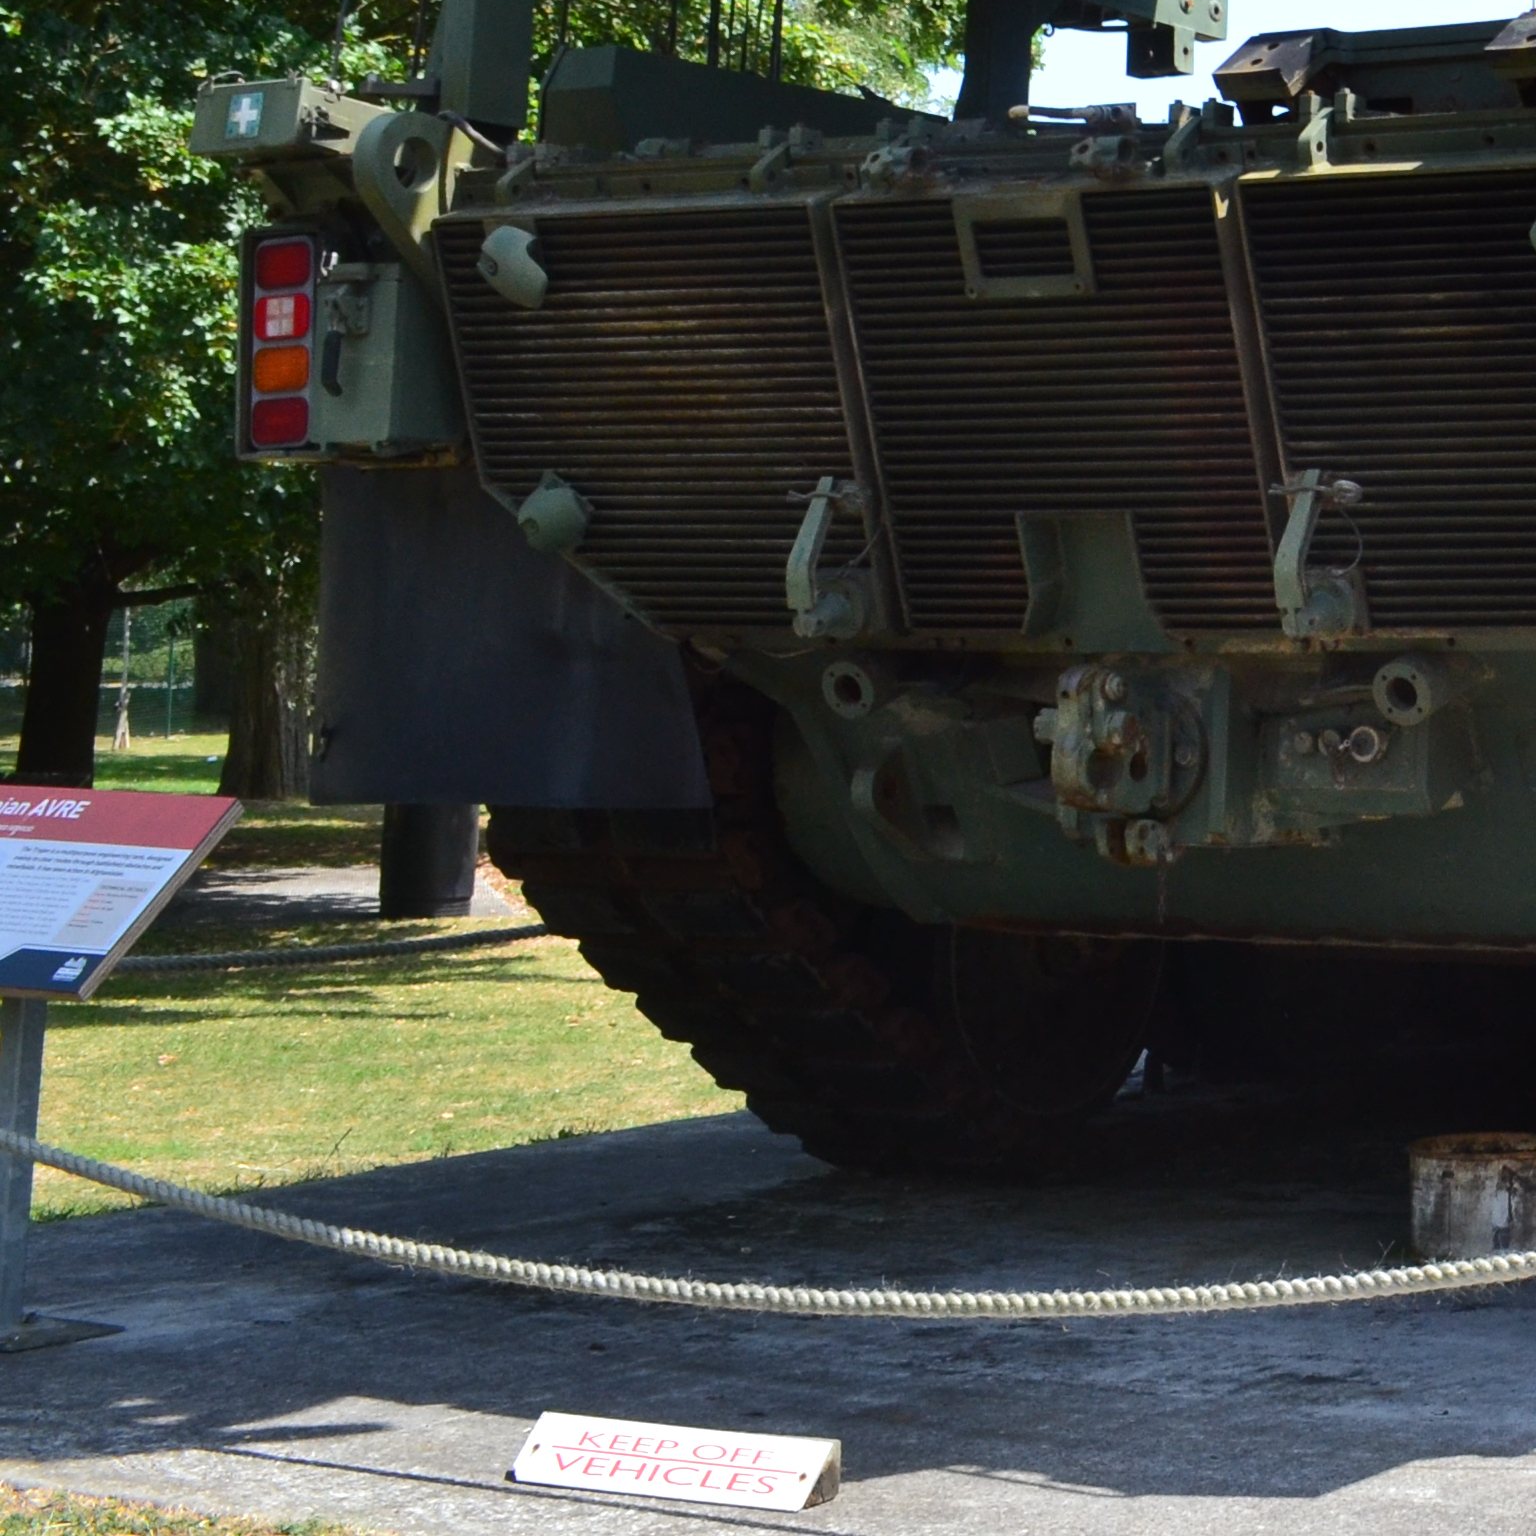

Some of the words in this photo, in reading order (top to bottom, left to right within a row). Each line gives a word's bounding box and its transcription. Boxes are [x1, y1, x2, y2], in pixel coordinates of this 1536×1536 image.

[28, 798, 92, 819] AVRE
[578, 1430, 680, 1455] KEEP
[692, 1444, 775, 1465] OFF
[554, 1452, 779, 1494] VEHICLES
